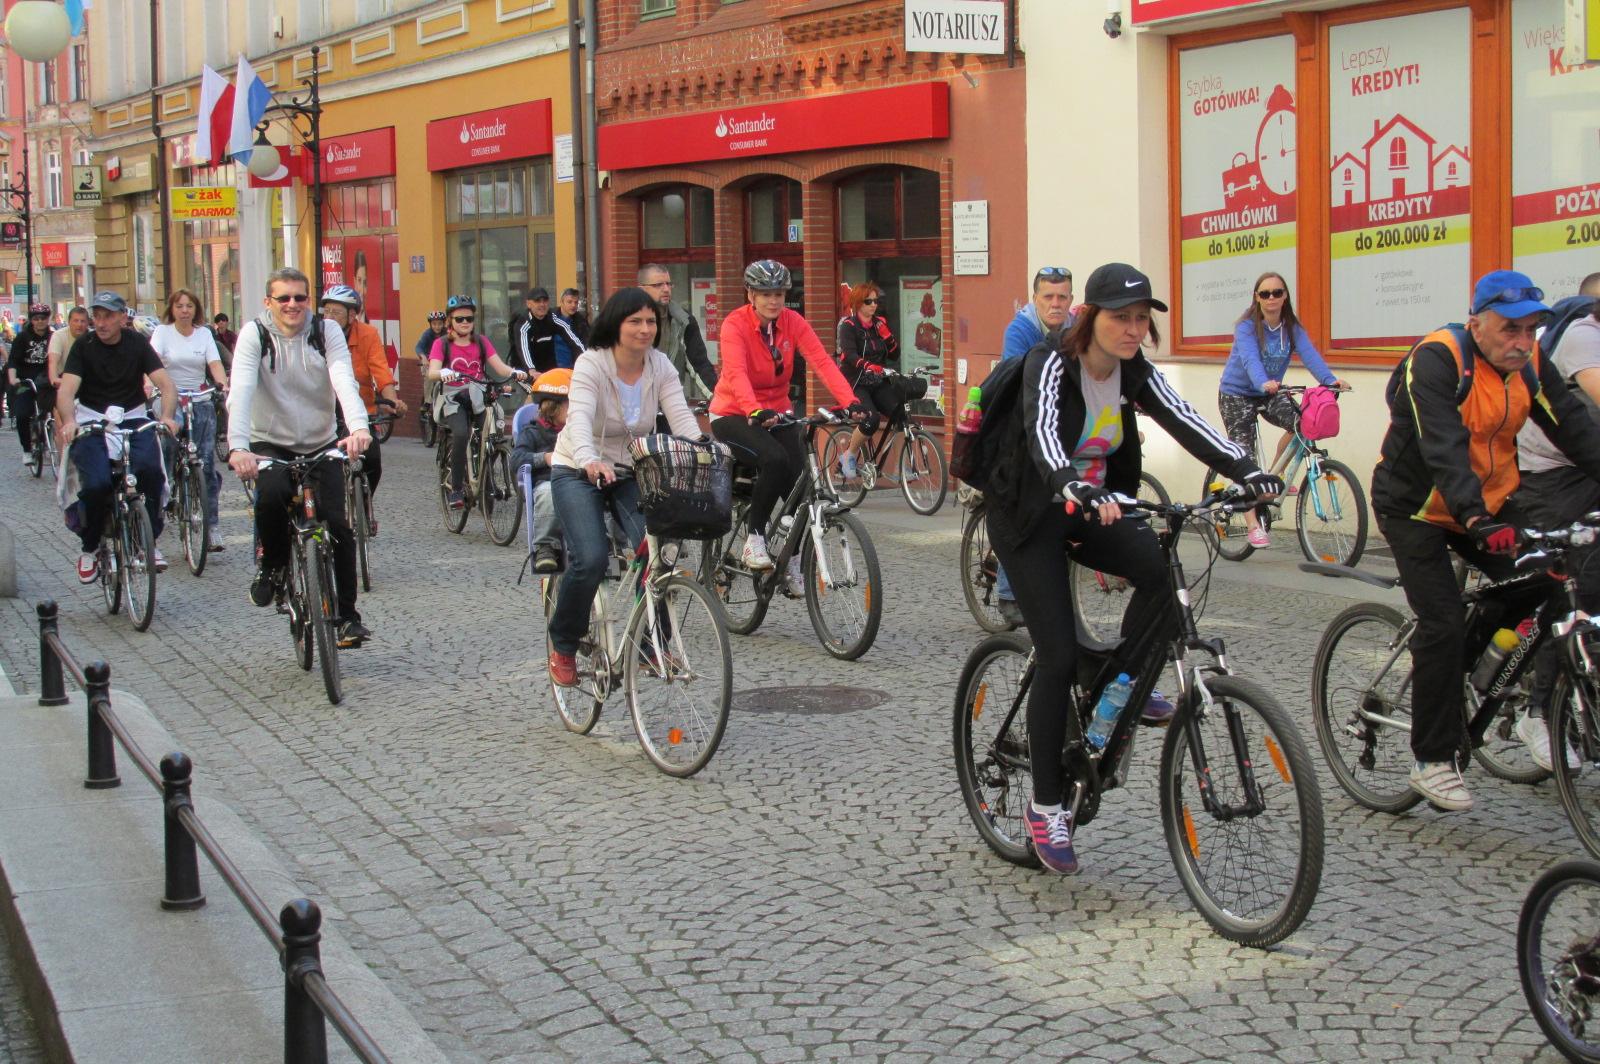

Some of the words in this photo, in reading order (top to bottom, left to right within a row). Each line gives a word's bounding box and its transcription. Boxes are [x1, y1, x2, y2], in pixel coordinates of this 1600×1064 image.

[912, 11, 999, 40] NOTARIUSZ
[1341, 43, 1391, 72] Lepszy
[1186, 74, 1222, 99] Szybka
[1351, 63, 1420, 97] KREDYT!
[1194, 86, 1260, 116] GOTÓWKA!
[470, 117, 507, 141] Santander
[729, 111, 776, 135] Santander
[334, 140, 361, 161] Santander
[729, 140, 754, 151] CONSUMER
[754, 138, 768, 148] BANK
[198, 188, 222, 200] żak
[191, 207, 235, 217] DARMO!
[1201, 204, 1277, 234] CHWILÓWKI
[1368, 195, 1433, 222] KREDYTY
[1208, 239, 1223, 257] do
[1226, 234, 1256, 254] 1.000
[1258, 230, 1270, 249] zł
[1355, 232, 1373, 252] do
[1376, 224, 1430, 249] 200.000
[1433, 220, 1447, 241] zł
[321, 244, 342, 268] Wejdź
